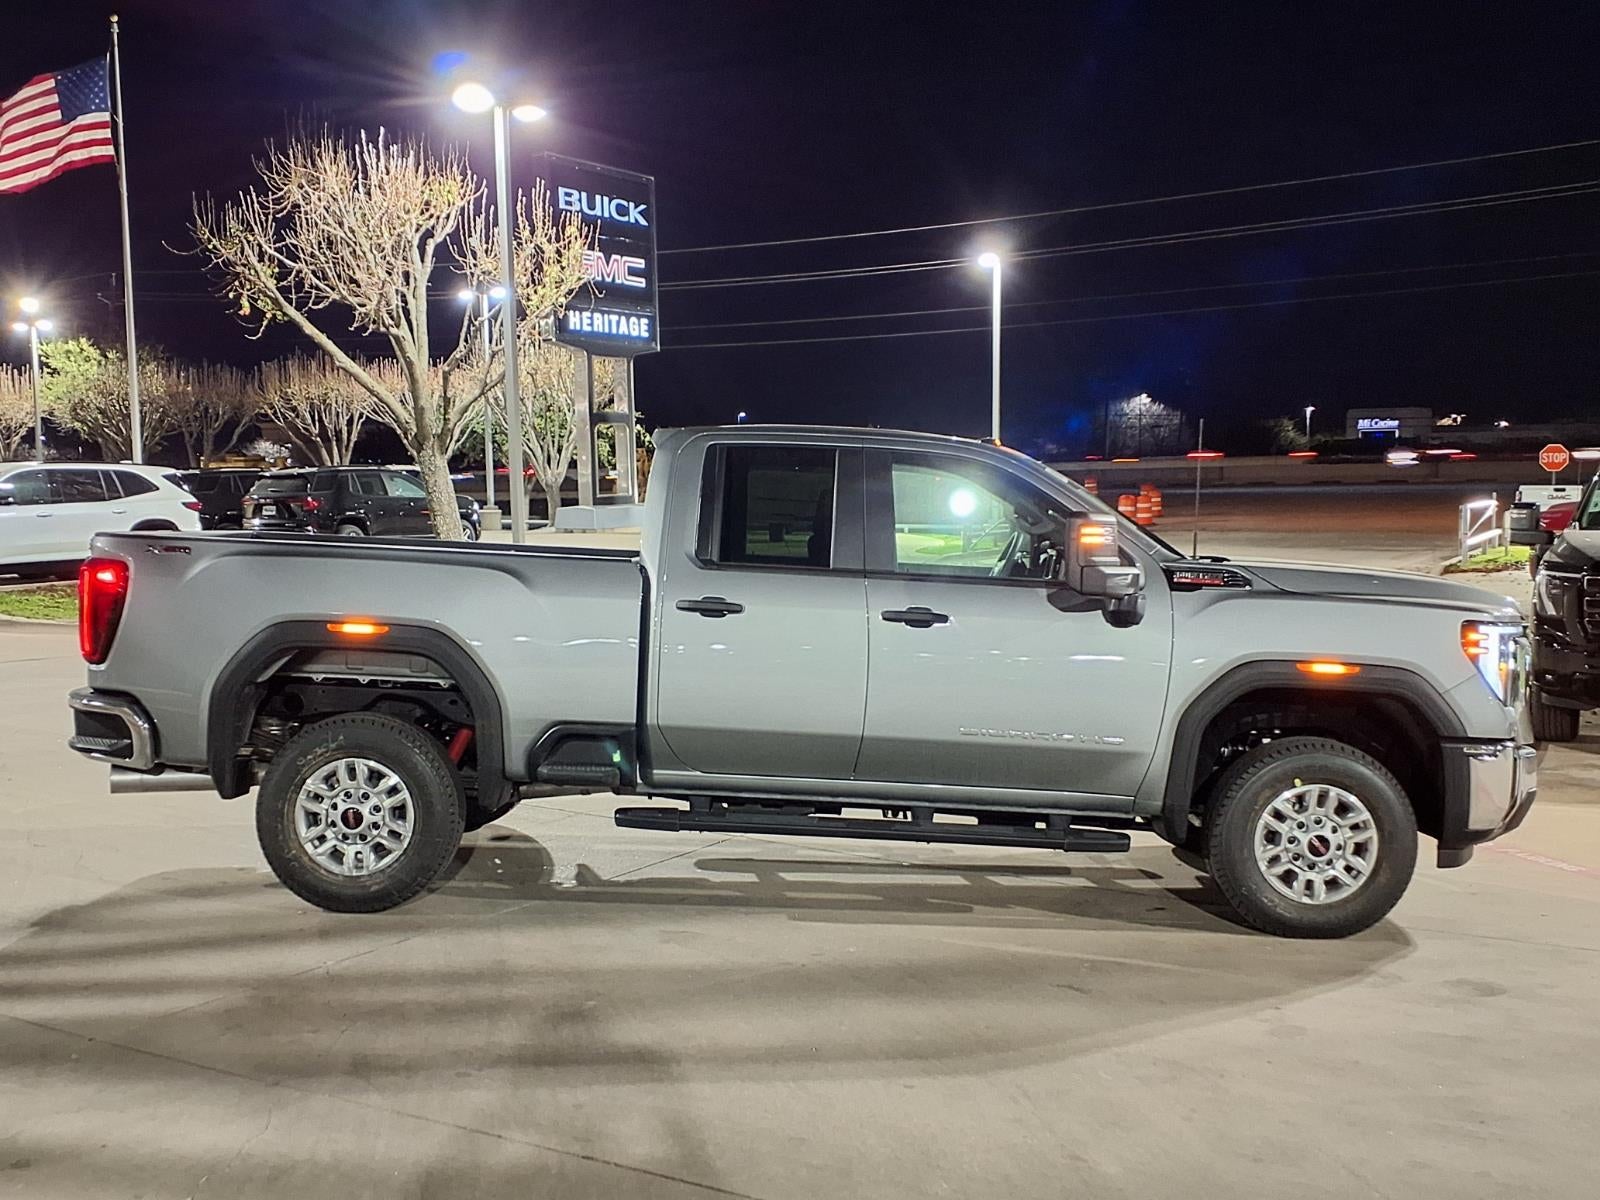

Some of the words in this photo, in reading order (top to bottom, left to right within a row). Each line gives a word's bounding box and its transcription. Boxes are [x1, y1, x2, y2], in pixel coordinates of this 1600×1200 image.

[557, 186, 649, 226] BUICK
[568, 310, 650, 338] HERITAGE
[1541, 452, 1567, 464] STOP
